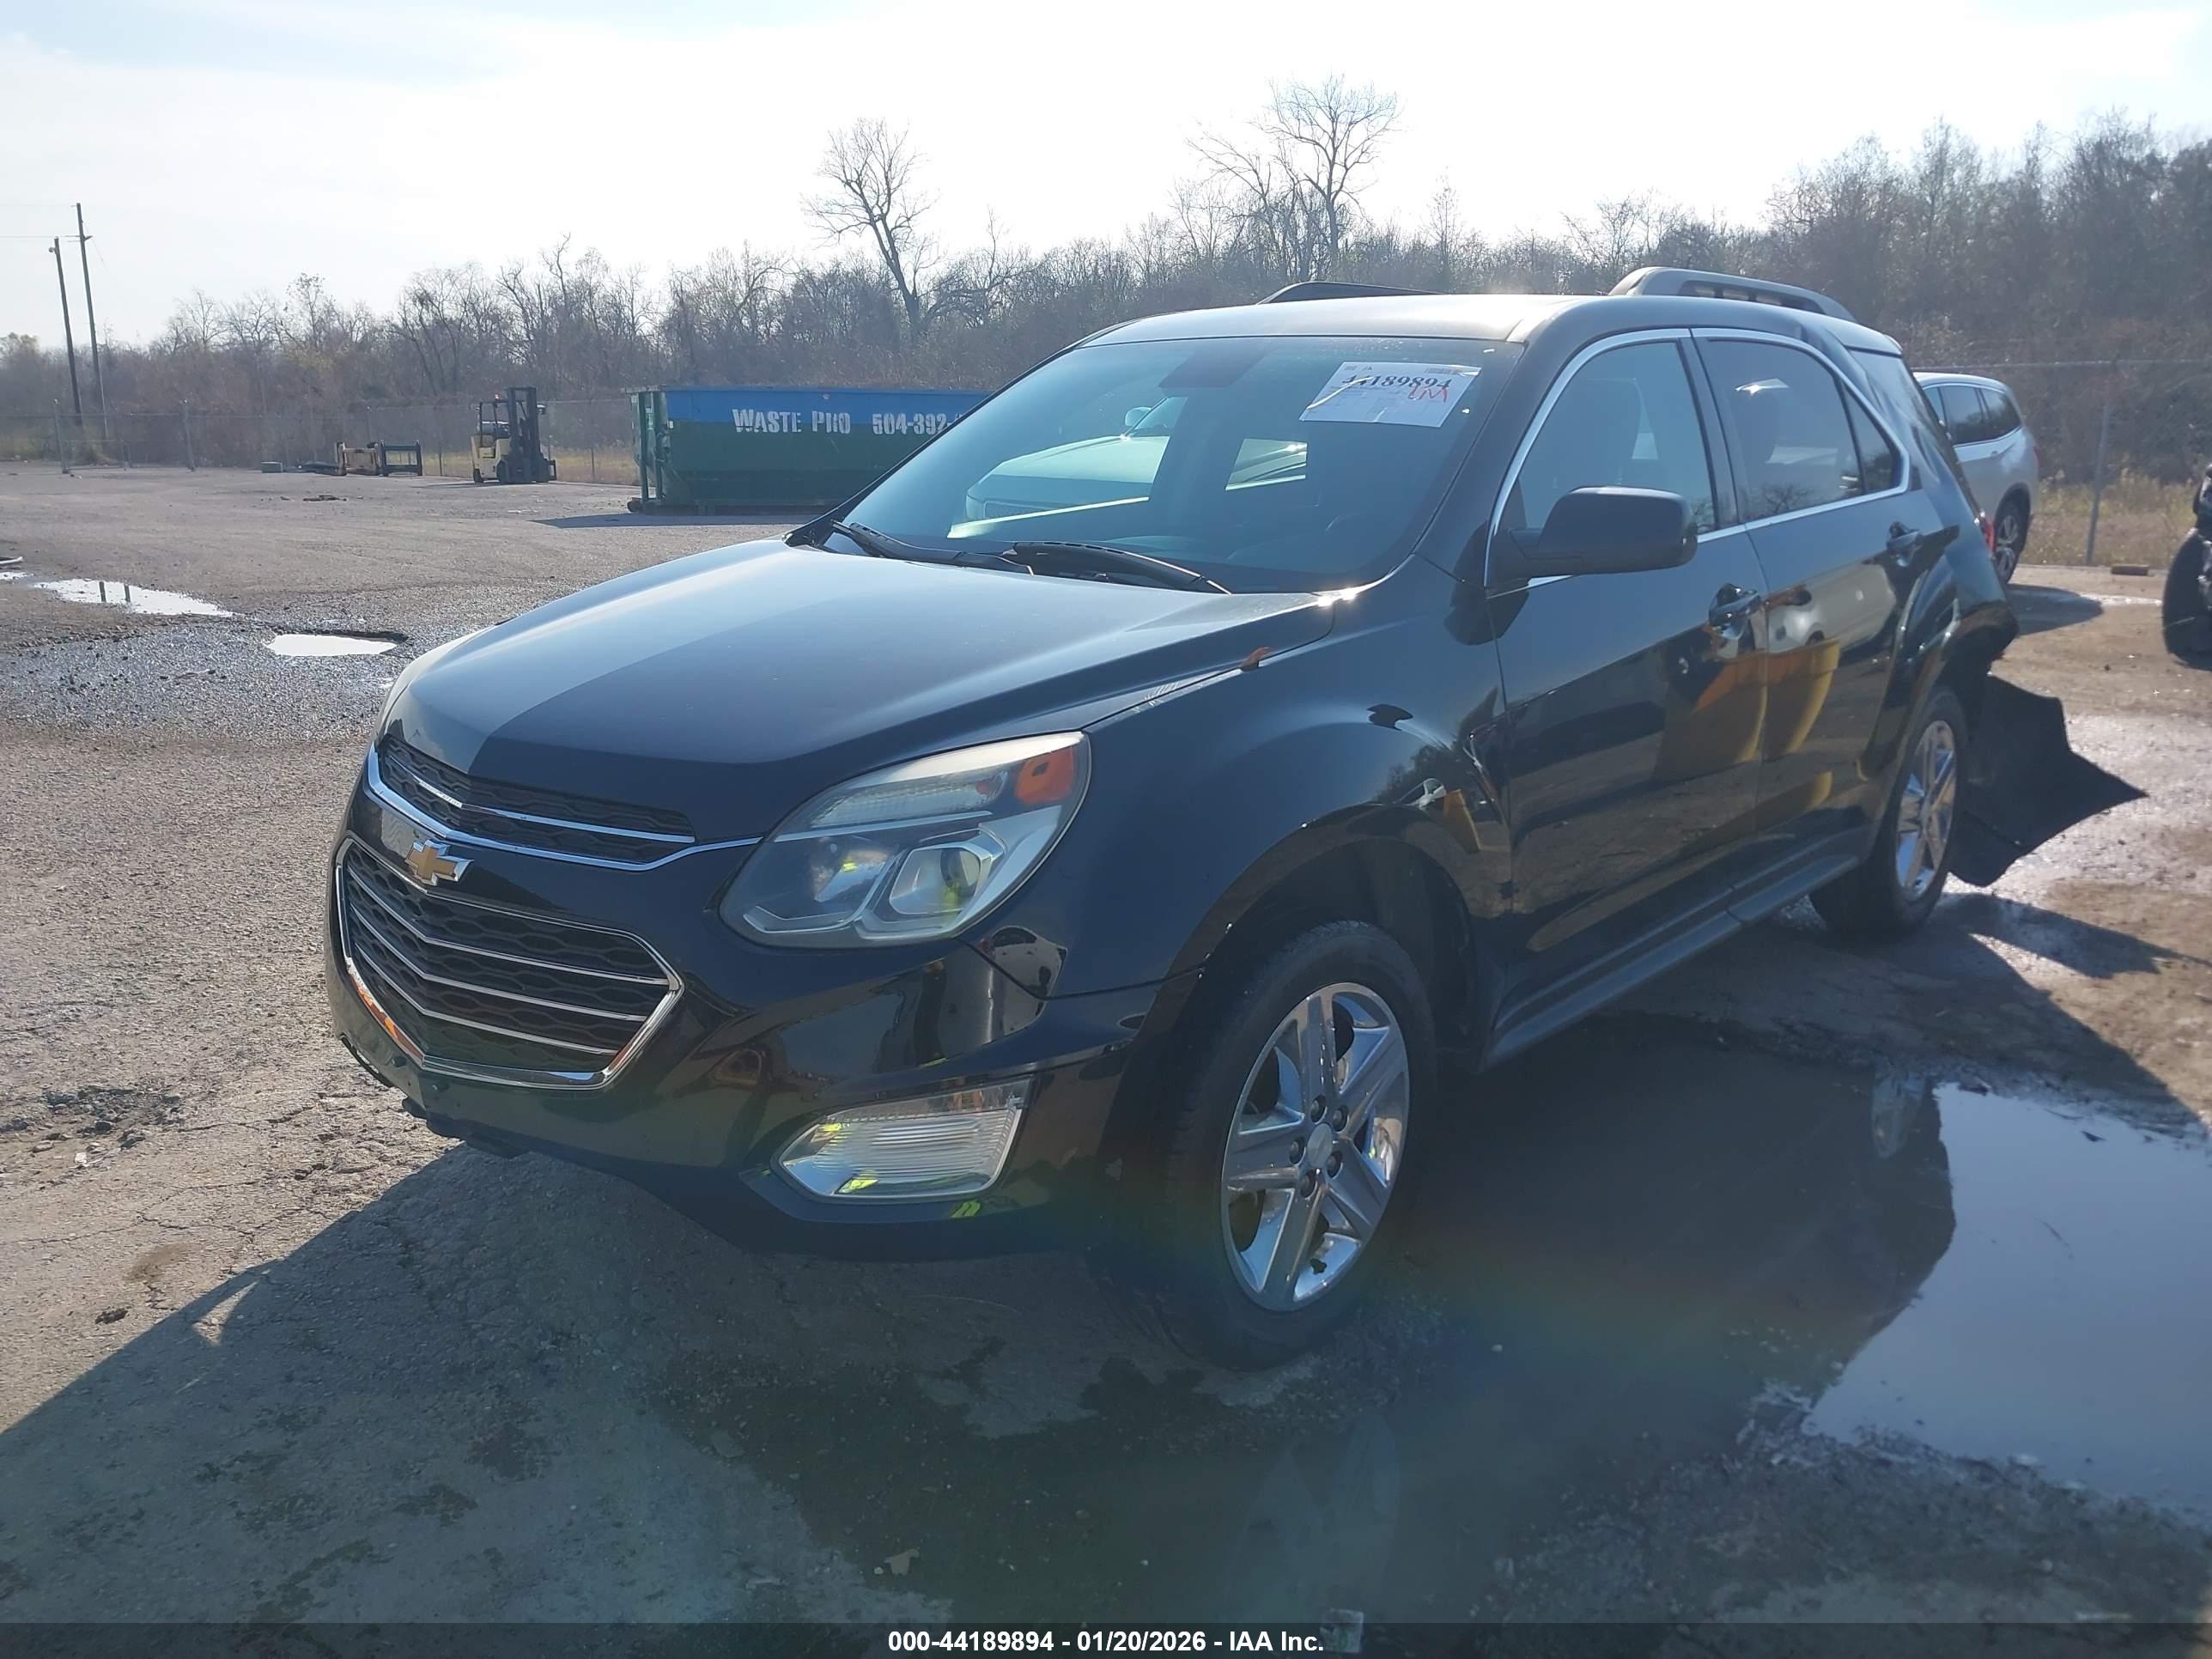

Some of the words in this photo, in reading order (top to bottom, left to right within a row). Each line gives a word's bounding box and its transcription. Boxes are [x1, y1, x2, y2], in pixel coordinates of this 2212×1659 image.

[732, 409, 801, 434] WASTE
[811, 410, 851, 434] PRO
[872, 413, 963, 435] 504-392-
